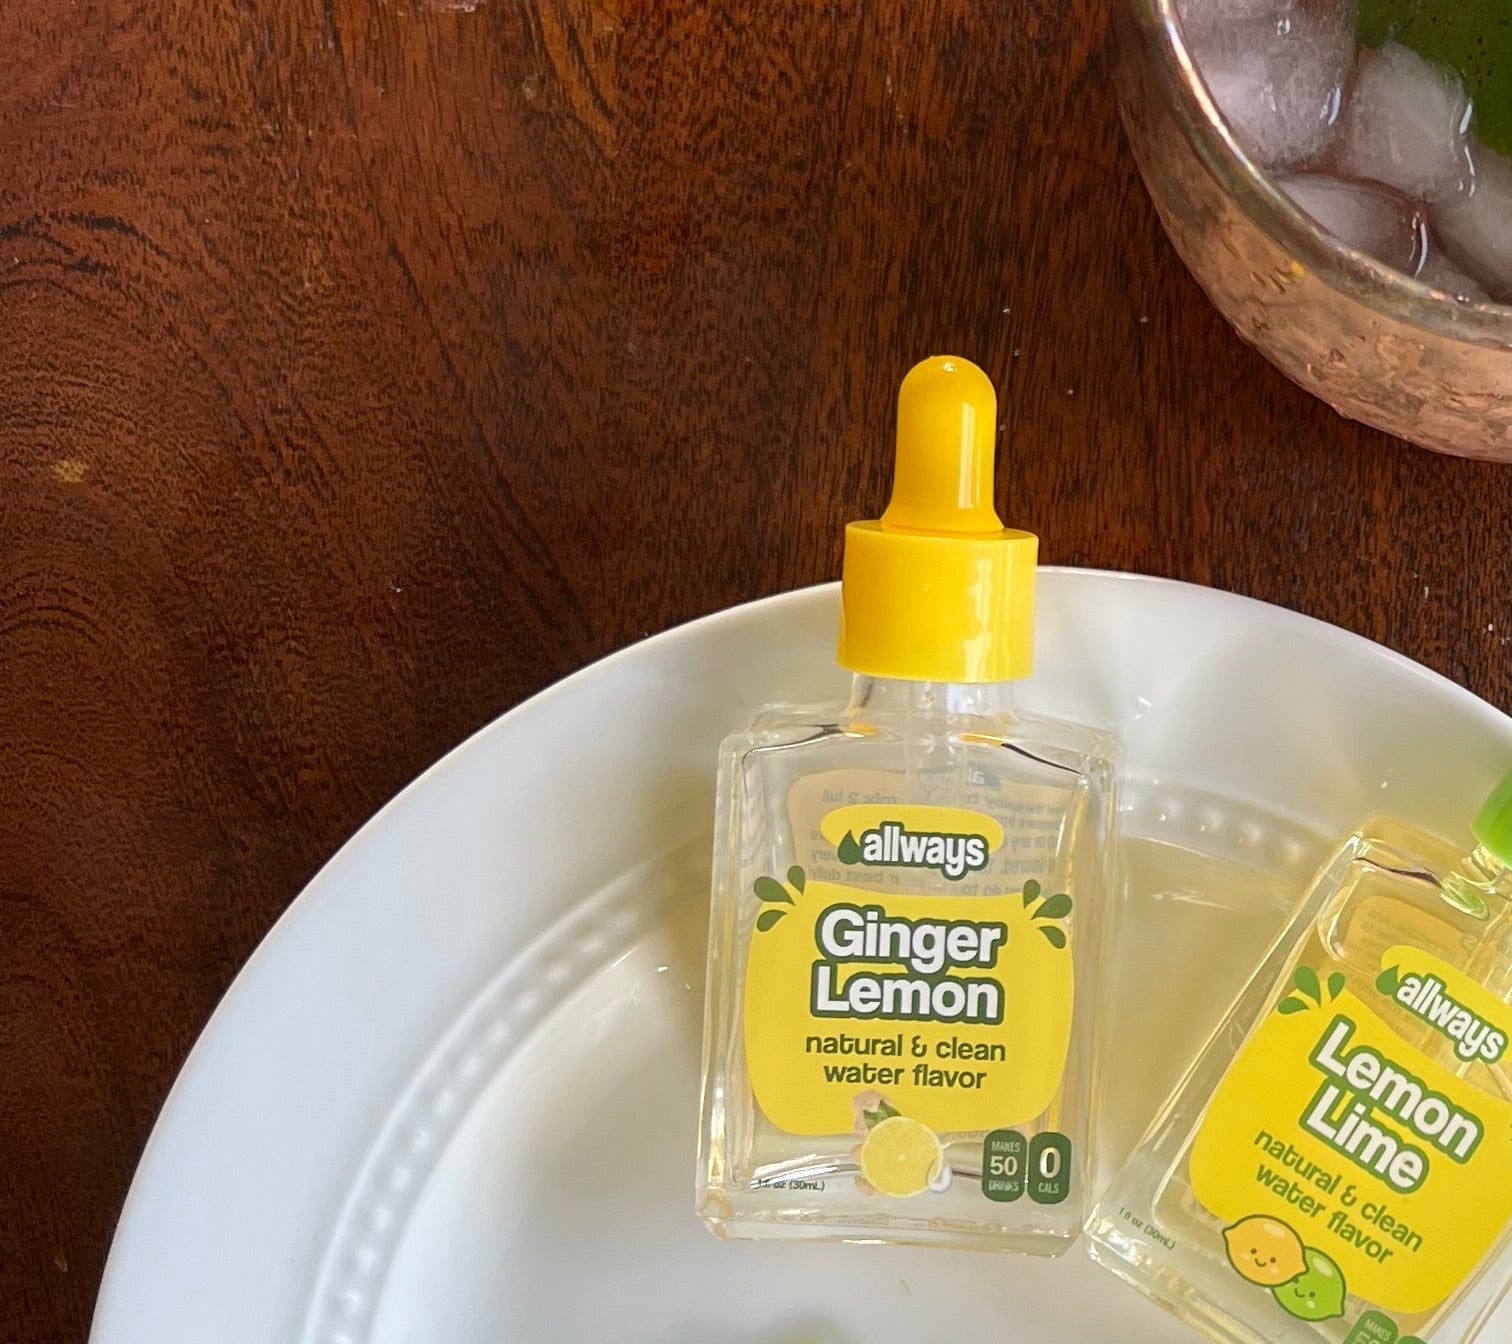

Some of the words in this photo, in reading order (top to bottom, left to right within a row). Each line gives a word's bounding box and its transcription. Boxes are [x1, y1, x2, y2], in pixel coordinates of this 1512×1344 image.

[863, 827, 985, 876] allways
[821, 909, 1001, 973] Ginger
[816, 966, 998, 1019] Lemon
[1396, 976, 1504, 1059] allways
[805, 1034, 902, 1056] natural
[911, 1036, 927, 1058] &
[936, 1038, 1006, 1061] clean
[824, 1064, 904, 1086] water
[913, 1065, 987, 1089] flavor
[1315, 1021, 1478, 1158] Lemon
[991, 1141, 1021, 1153] MAKES
[1306, 1084, 1425, 1189] Lime
[990, 1155, 1018, 1176] 50
[1039, 1146, 1061, 1179] 0
[988, 1179, 1020, 1192] DRINKS
[1037, 1182, 1060, 1194] CALS
[1253, 1130, 1343, 1195] natural
[1340, 1184, 1358, 1207] &
[1361, 1201, 1424, 1252] clean
[1255, 1163, 1327, 1219] water
[1327, 1210, 1394, 1264] flavor
[1363, 1318, 1392, 1342] MAKES
